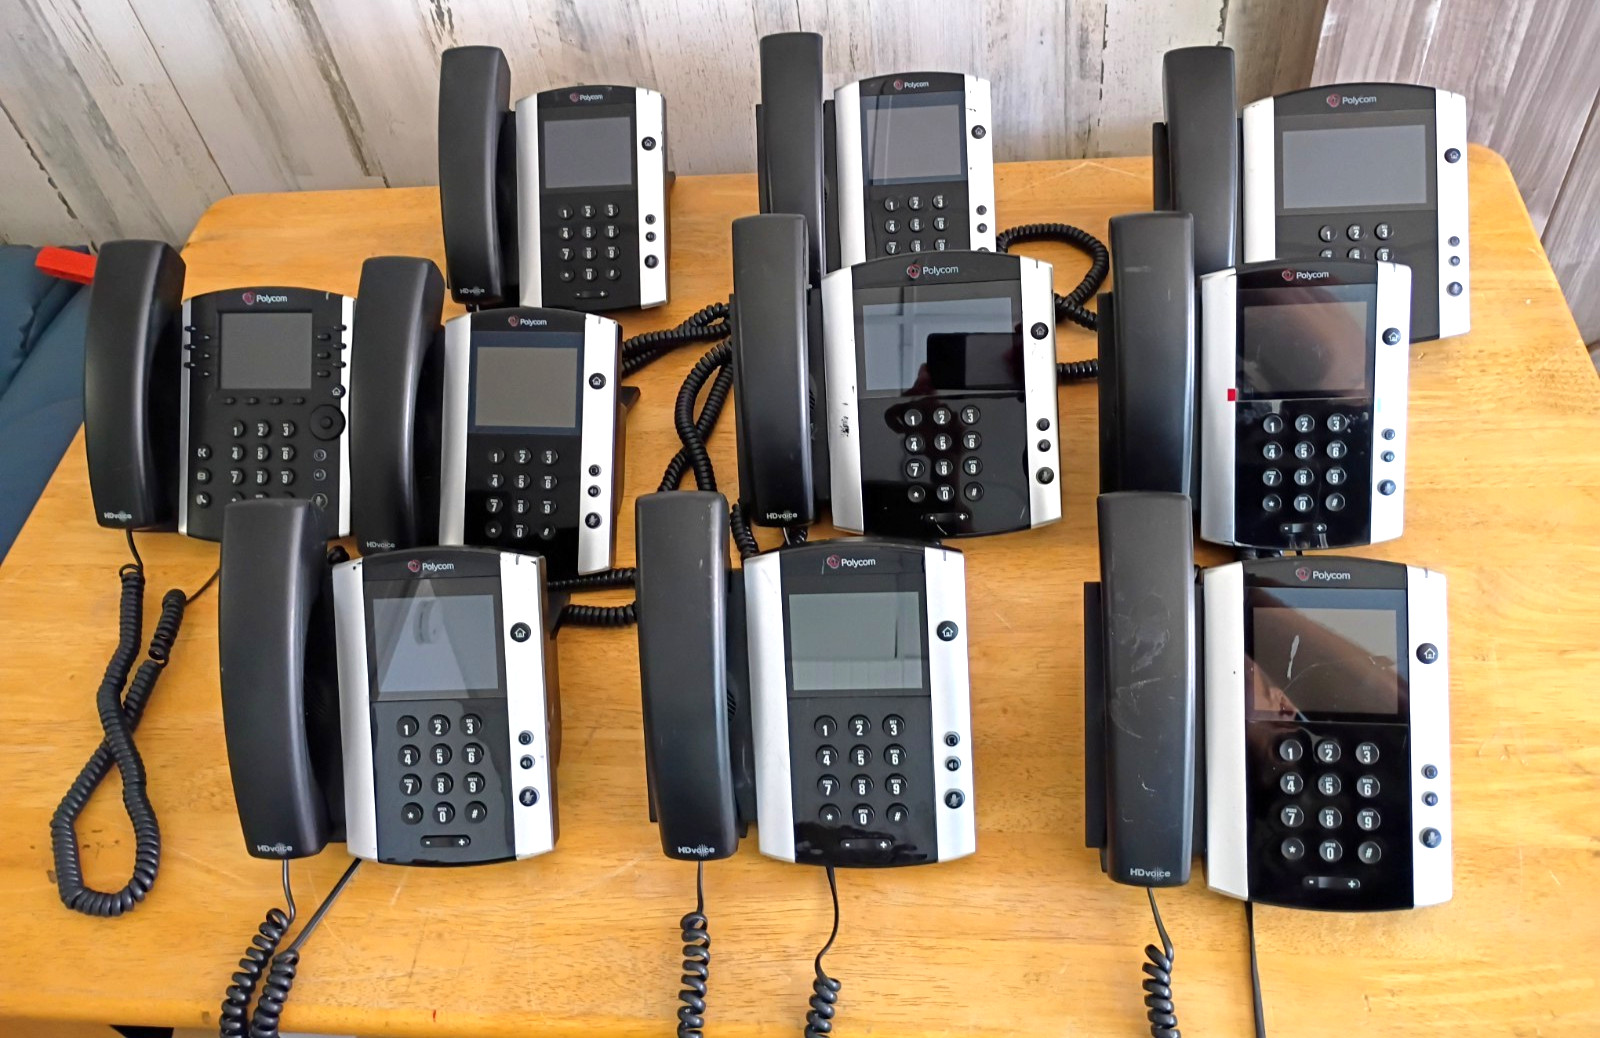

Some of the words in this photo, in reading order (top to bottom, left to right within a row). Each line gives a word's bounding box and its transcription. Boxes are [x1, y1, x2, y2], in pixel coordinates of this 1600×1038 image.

[1342, 96, 1376, 105] Polycom
[890, 201, 893, 210] 1
[913, 201, 918, 209] 2
[938, 199, 943, 208] 3
[890, 224, 895, 232] 4
[914, 222, 919, 230] 5
[939, 221, 944, 229] 6
[1326, 231, 1330, 240] 1
[1354, 230, 1359, 239] 2
[1382, 229, 1388, 238] 3
[890, 245, 895, 253] 7
[923, 266, 958, 276] Polycom
[1296, 272, 1329, 280] Polycom
[256, 294, 287, 303] Polycom
[911, 416, 915, 426] 1
[939, 415, 945, 424] 2
[968, 413, 973, 423] 3
[233, 427, 237, 436] 1
[258, 427, 263, 436] 2
[283, 427, 288, 436] 3
[1270, 422, 1274, 432] 1
[1302, 421, 1307, 431] 2
[1333, 420, 1340, 430] 3
[911, 442, 917, 451] 4
[940, 440, 946, 450] 5
[969, 439, 974, 448] 6
[232, 450, 238, 459] 4
[257, 451, 263, 460] 5
[494, 453, 498, 462] 1
[519, 454, 525, 463] 2
[546, 454, 552, 464] 3
[1269, 448, 1275, 459] 4
[1301, 448, 1307, 458] 5
[1332, 447, 1339, 457] 6
[912, 467, 918, 476] 7
[941, 465, 947, 475] 8
[970, 464, 976, 474] 9
[232, 474, 238, 483] 7
[282, 475, 288, 484] 9
[492, 478, 498, 487] 4
[518, 479, 524, 488] 5
[1269, 475, 1274, 484] 7
[1300, 474, 1306, 484] 8
[1332, 474, 1338, 483] 9
[942, 490, 948, 500] 0
[492, 503, 497, 512] 7
[544, 504, 550, 514] 9
[1300, 501, 1306, 510] 0
[517, 528, 522, 538] 0
[422, 562, 454, 571] Polycom
[841, 558, 876, 568] Polycom
[1313, 571, 1350, 580] Polycom
[404, 724, 409, 736] 1
[435, 724, 442, 735] 2
[467, 723, 473, 734] 3
[823, 725, 828, 736] 1
[856, 724, 863, 736] 2
[891, 724, 897, 735] 3
[404, 754, 411, 765] 4
[436, 753, 443, 764] 5
[468, 752, 475, 763] 6
[823, 755, 830, 766] 4
[857, 754, 864, 765] 5
[892, 754, 899, 765] 6
[1288, 748, 1293, 760] 1
[1325, 749, 1333, 761] 2
[1363, 751, 1371, 763] 3
[406, 783, 412, 794] 7
[438, 782, 444, 793] 8
[470, 782, 476, 793] 9
[824, 785, 831, 796] 7
[859, 784, 865, 795] 8
[893, 784, 900, 795] 9
[1287, 780, 1295, 793] 4
[1325, 782, 1333, 794] 5
[1364, 784, 1372, 796] 6
[439, 812, 446, 822] 0
[860, 814, 867, 825] 0
[1288, 814, 1295, 826] 7
[1326, 815, 1334, 827] 8
[1364, 817, 1372, 829] 9
[1326, 848, 1334, 860] 0
[1130, 868, 1170, 877] HDvoice
